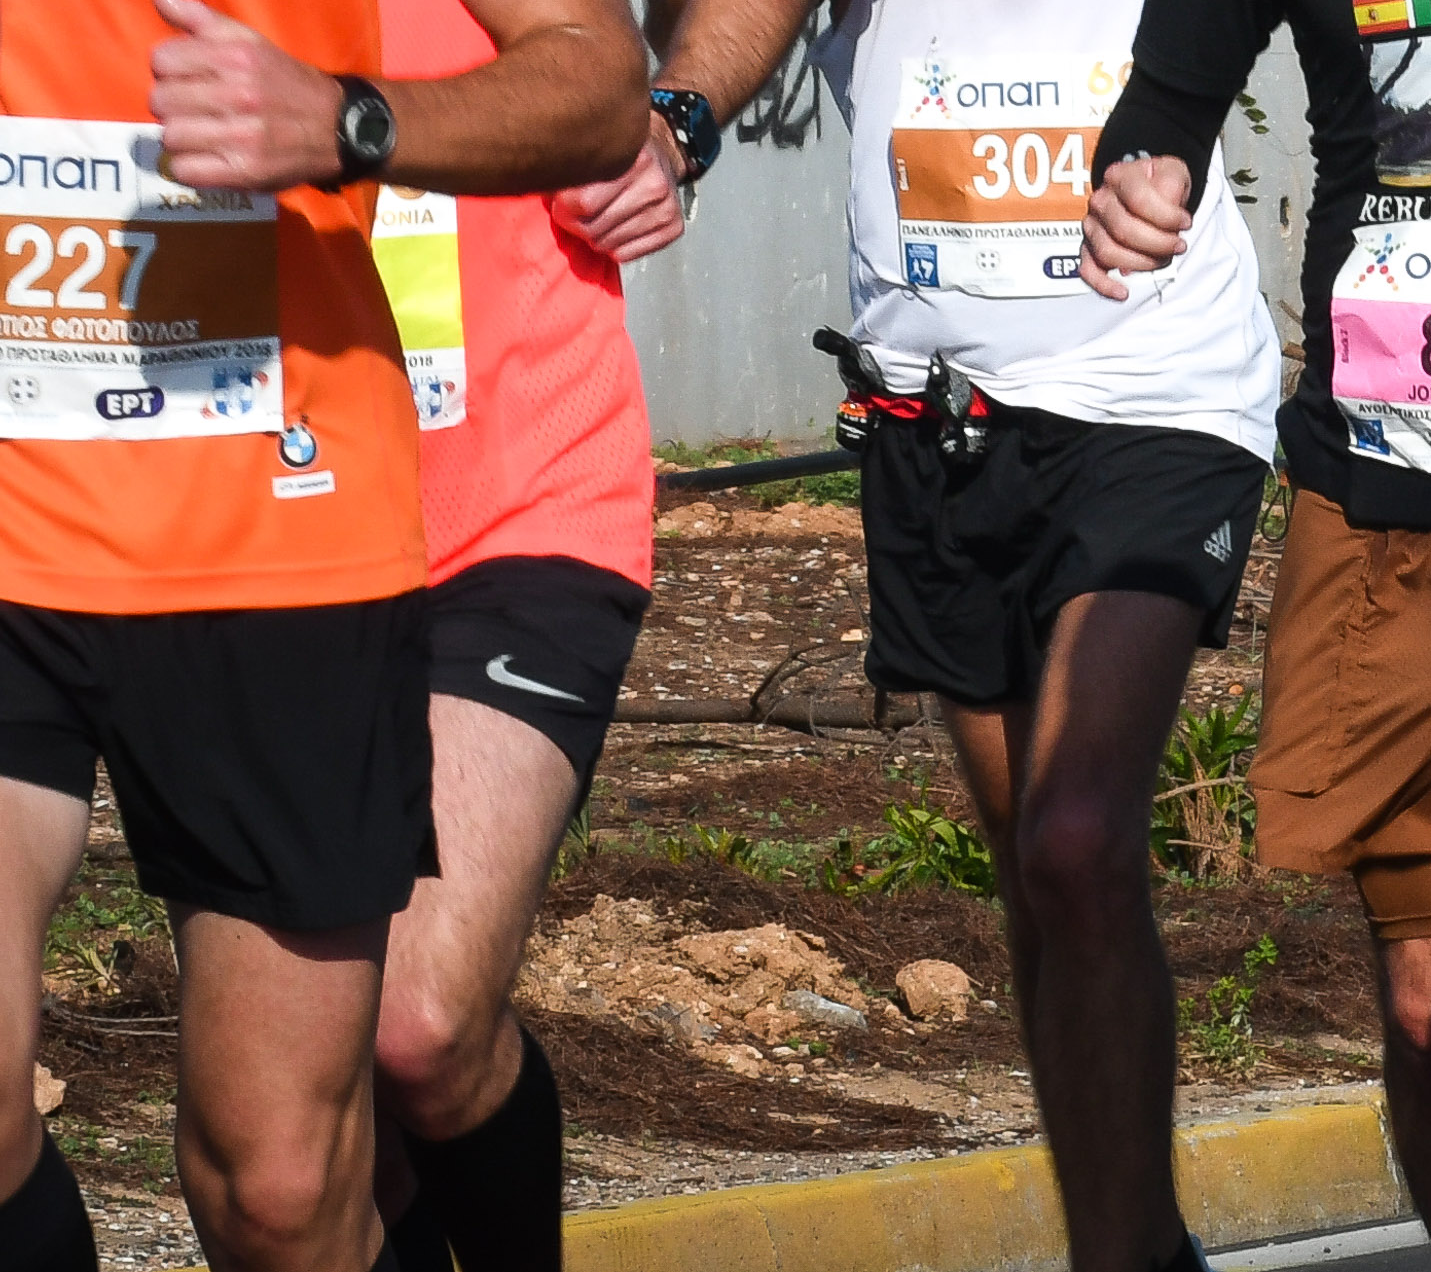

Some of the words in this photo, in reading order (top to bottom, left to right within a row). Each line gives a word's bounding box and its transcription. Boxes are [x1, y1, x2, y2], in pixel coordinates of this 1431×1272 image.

[971, 131, 1092, 201] 304
[379, 208, 436, 227] ΟΝΙΑ
[3, 222, 158, 312] 227
[51, 314, 201, 342] ΦΩΤΟΠΟΥΛΟΣ
[404, 354, 434, 369] 018
[105, 392, 157, 417] ΕΡΤ
